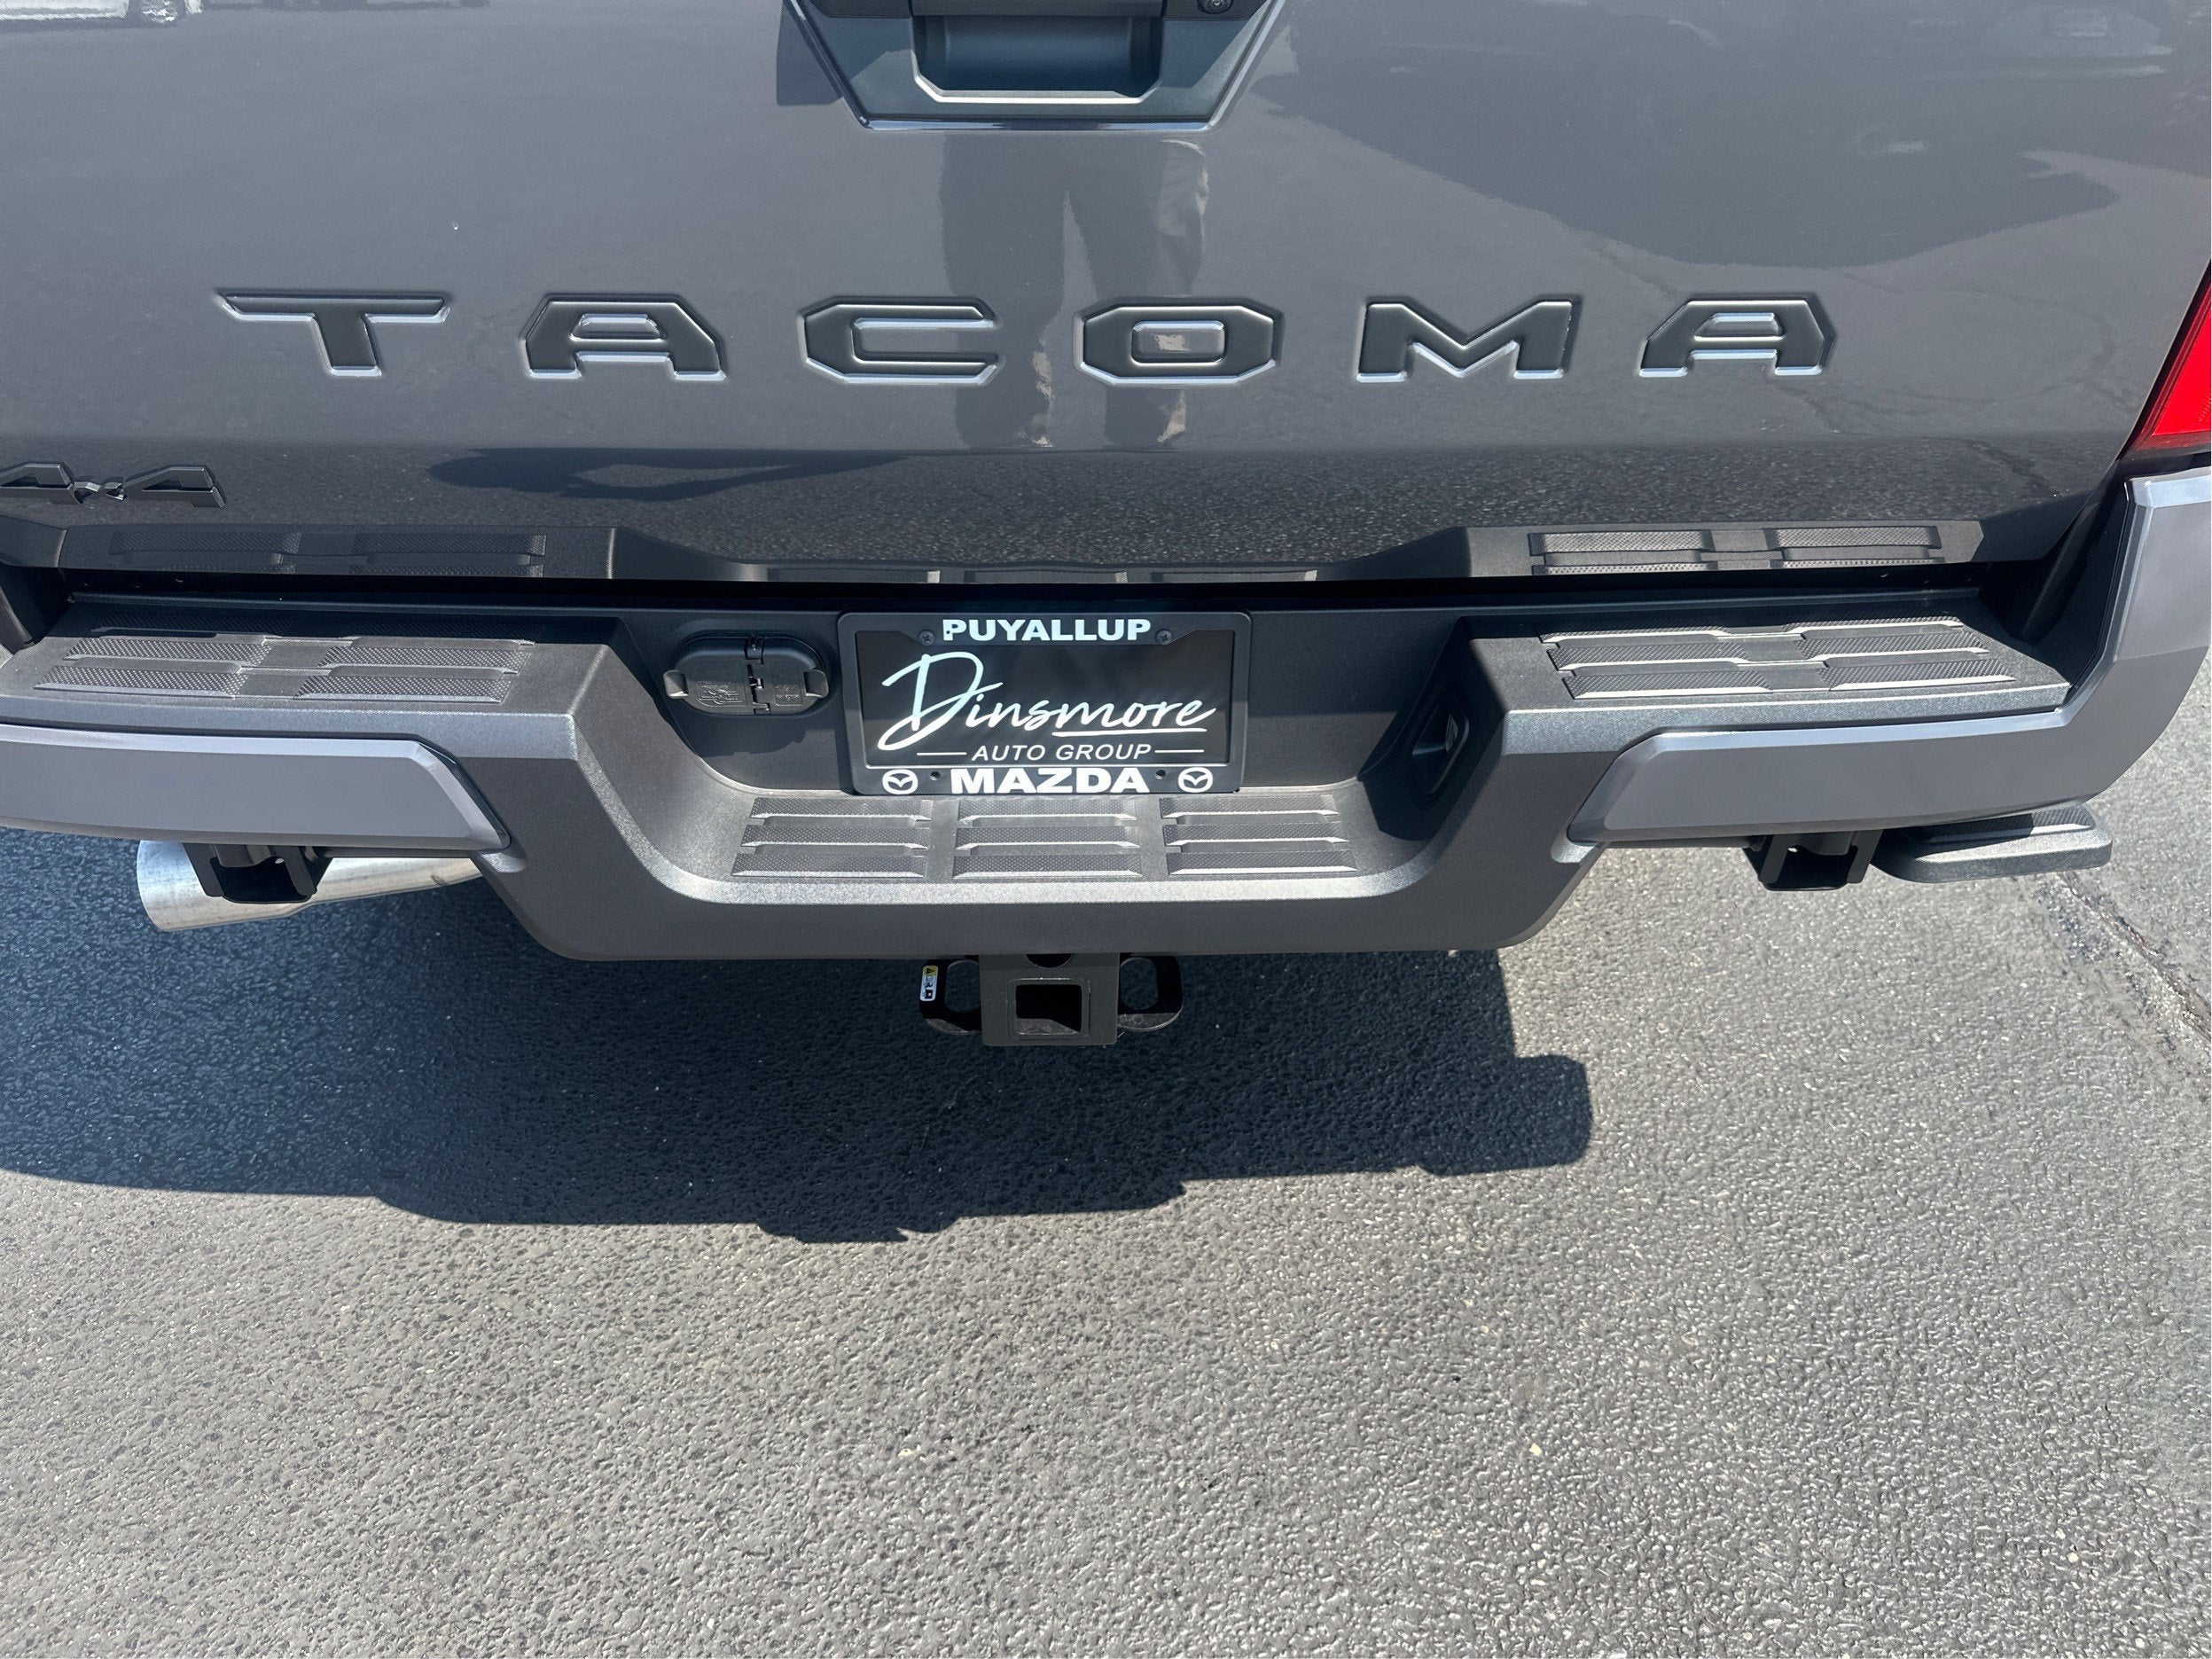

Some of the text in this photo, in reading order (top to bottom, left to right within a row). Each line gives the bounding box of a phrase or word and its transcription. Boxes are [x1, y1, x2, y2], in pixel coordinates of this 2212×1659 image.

[219, 291, 1837, 385] TACOMA
[942, 618, 1151, 642] PUYALLUP
[877, 652, 1216, 751] Dinsmore
[972, 743, 1152, 761] AUTO GROUP
[950, 767, 1150, 794] MAZDA
